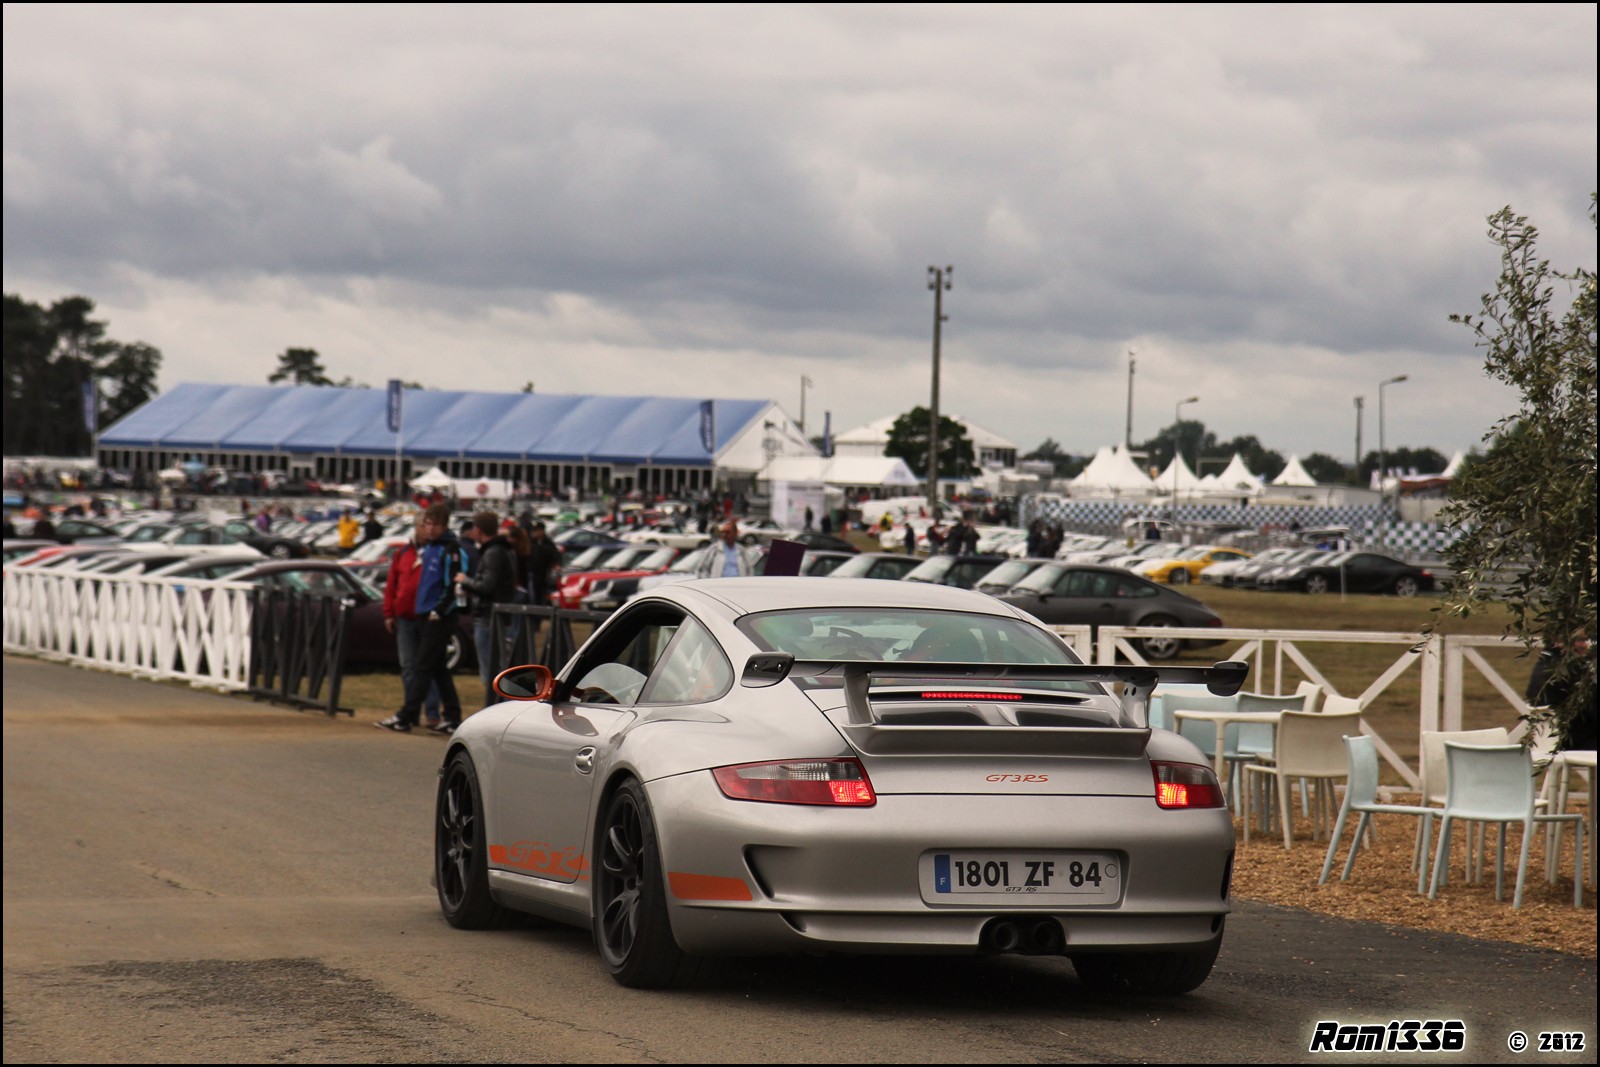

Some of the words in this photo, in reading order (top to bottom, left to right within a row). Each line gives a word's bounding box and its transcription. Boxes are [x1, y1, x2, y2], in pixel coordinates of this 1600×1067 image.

[940, 877, 946, 885] F
[955, 861, 1009, 887] 1801
[1024, 861, 1054, 887] ZF
[1069, 861, 1101, 887] 84
